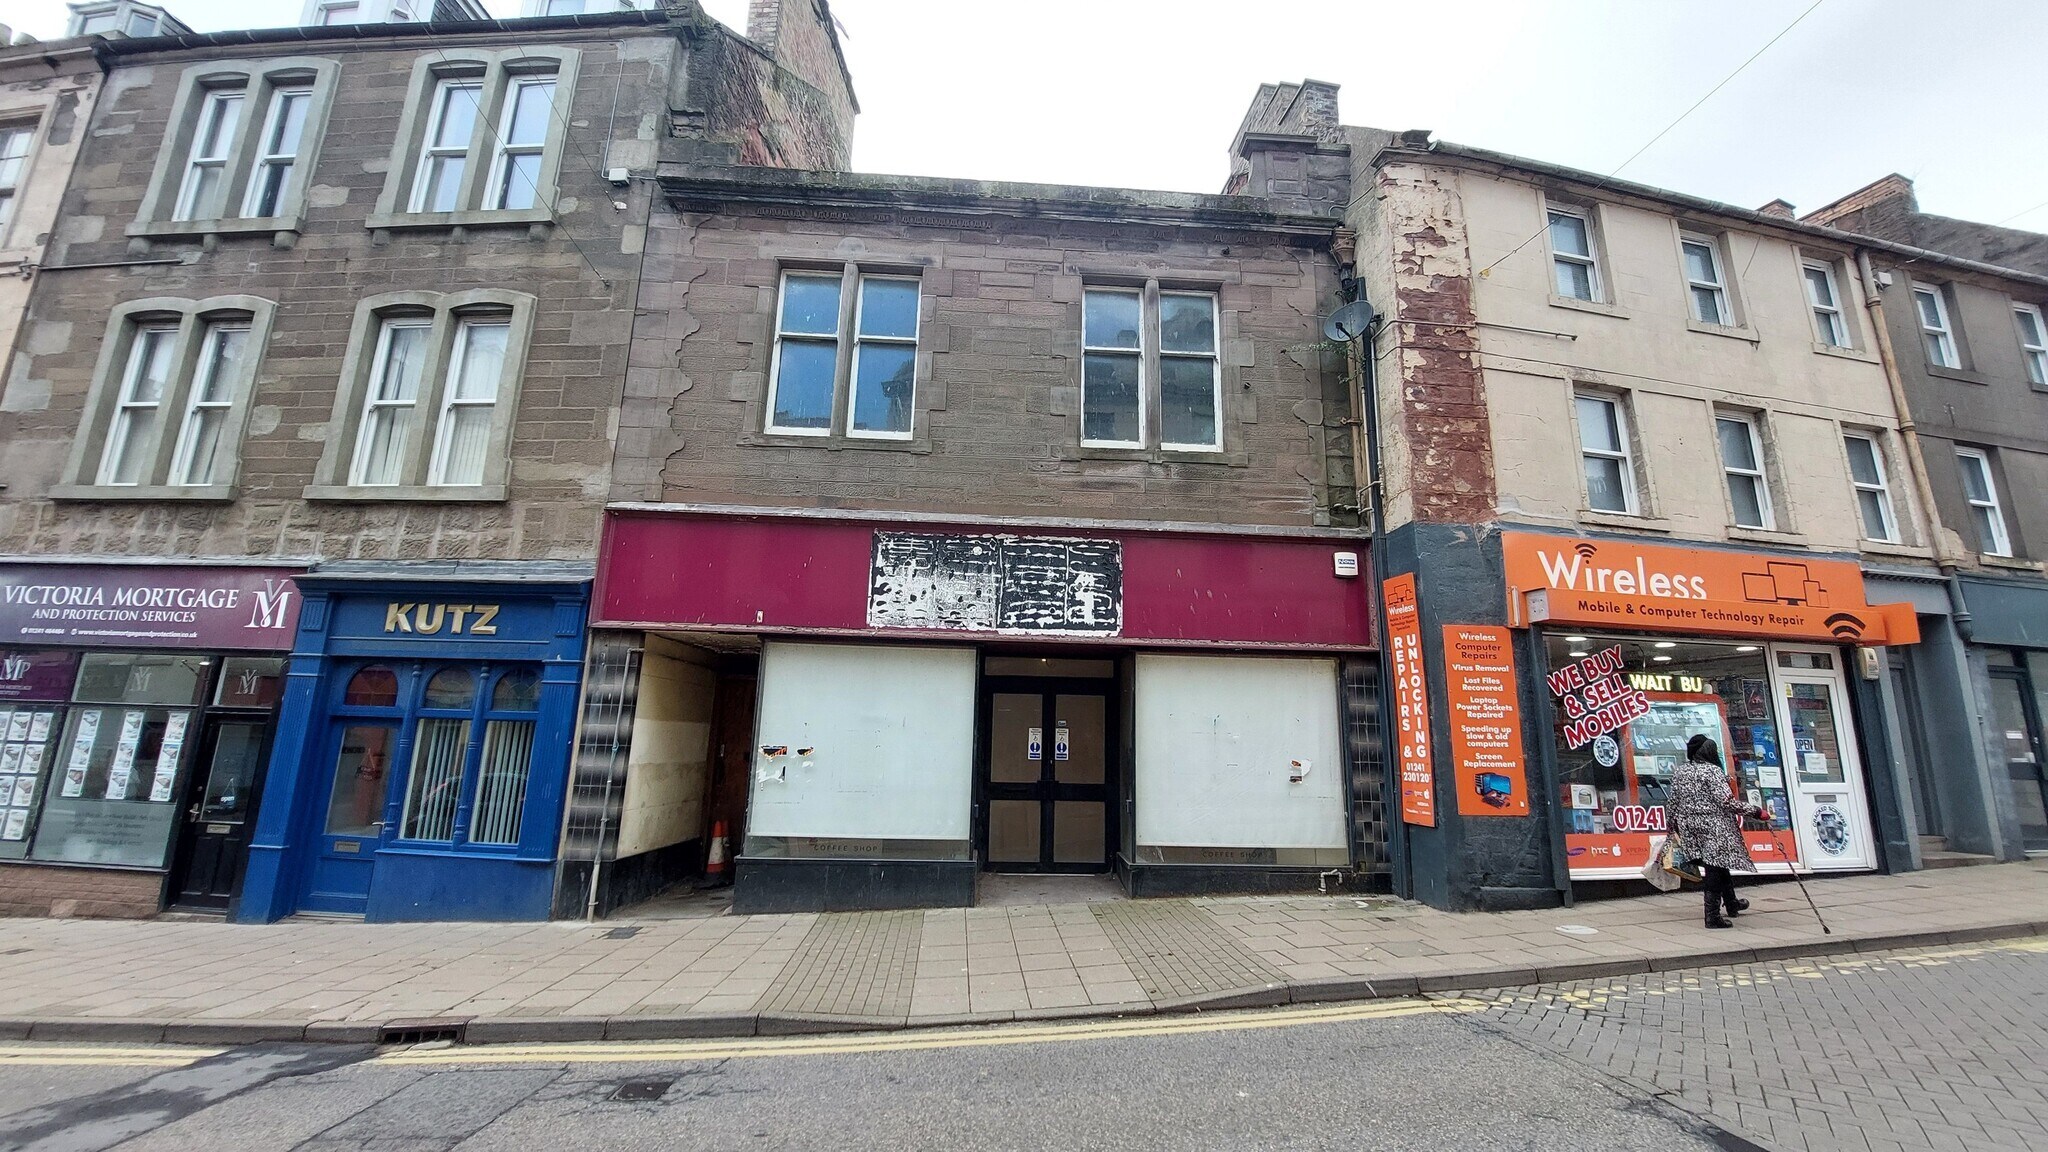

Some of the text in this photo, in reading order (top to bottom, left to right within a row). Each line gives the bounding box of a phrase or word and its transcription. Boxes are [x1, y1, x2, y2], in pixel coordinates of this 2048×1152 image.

[1537, 550, 1706, 599] Wireless
[4, 585, 239, 609] VICTORIA MORTGAGE
[32, 609, 196, 623] AND PROTECTION SERVICES
[1388, 604, 1415, 616] Wireless
[1578, 600, 1805, 627] Mobile & Computer Technology Repair
[383, 602, 499, 635] KUTZ
[1459, 632, 1496, 641] Wireless
[1455, 642, 1502, 653] Computer
[1461, 651, 1497, 660] Repairs
[1452, 664, 1474, 672] Virus
[1546, 644, 1625, 697] WE BUY
[1462, 684, 1503, 692] Recovered
[1629, 674, 1703, 692] WAIT BU
[1393, 636, 1412, 758] REPAIRS &
[1406, 634, 1427, 758] UNLOCKING
[1470, 696, 1498, 705] Laptop
[1564, 672, 1632, 719] & SELL
[1483, 704, 1513, 712] Sockets
[1467, 711, 1504, 719] Repaired
[1563, 691, 1651, 750] MOBILES
[1461, 725, 1500, 734] Speeding
[1466, 732, 1485, 740] slow
[1795, 739, 1814, 751] OPEN
[1406, 762, 1425, 772] 01241
[1464, 760, 1516, 768] Replacement
[1403, 772, 1430, 783] 230120
[1612, 805, 1667, 830] 01241
[814, 844, 847, 852] COFFEE
[1591, 846, 1608, 855] htc
[1751, 843, 1772, 852] ASUS
